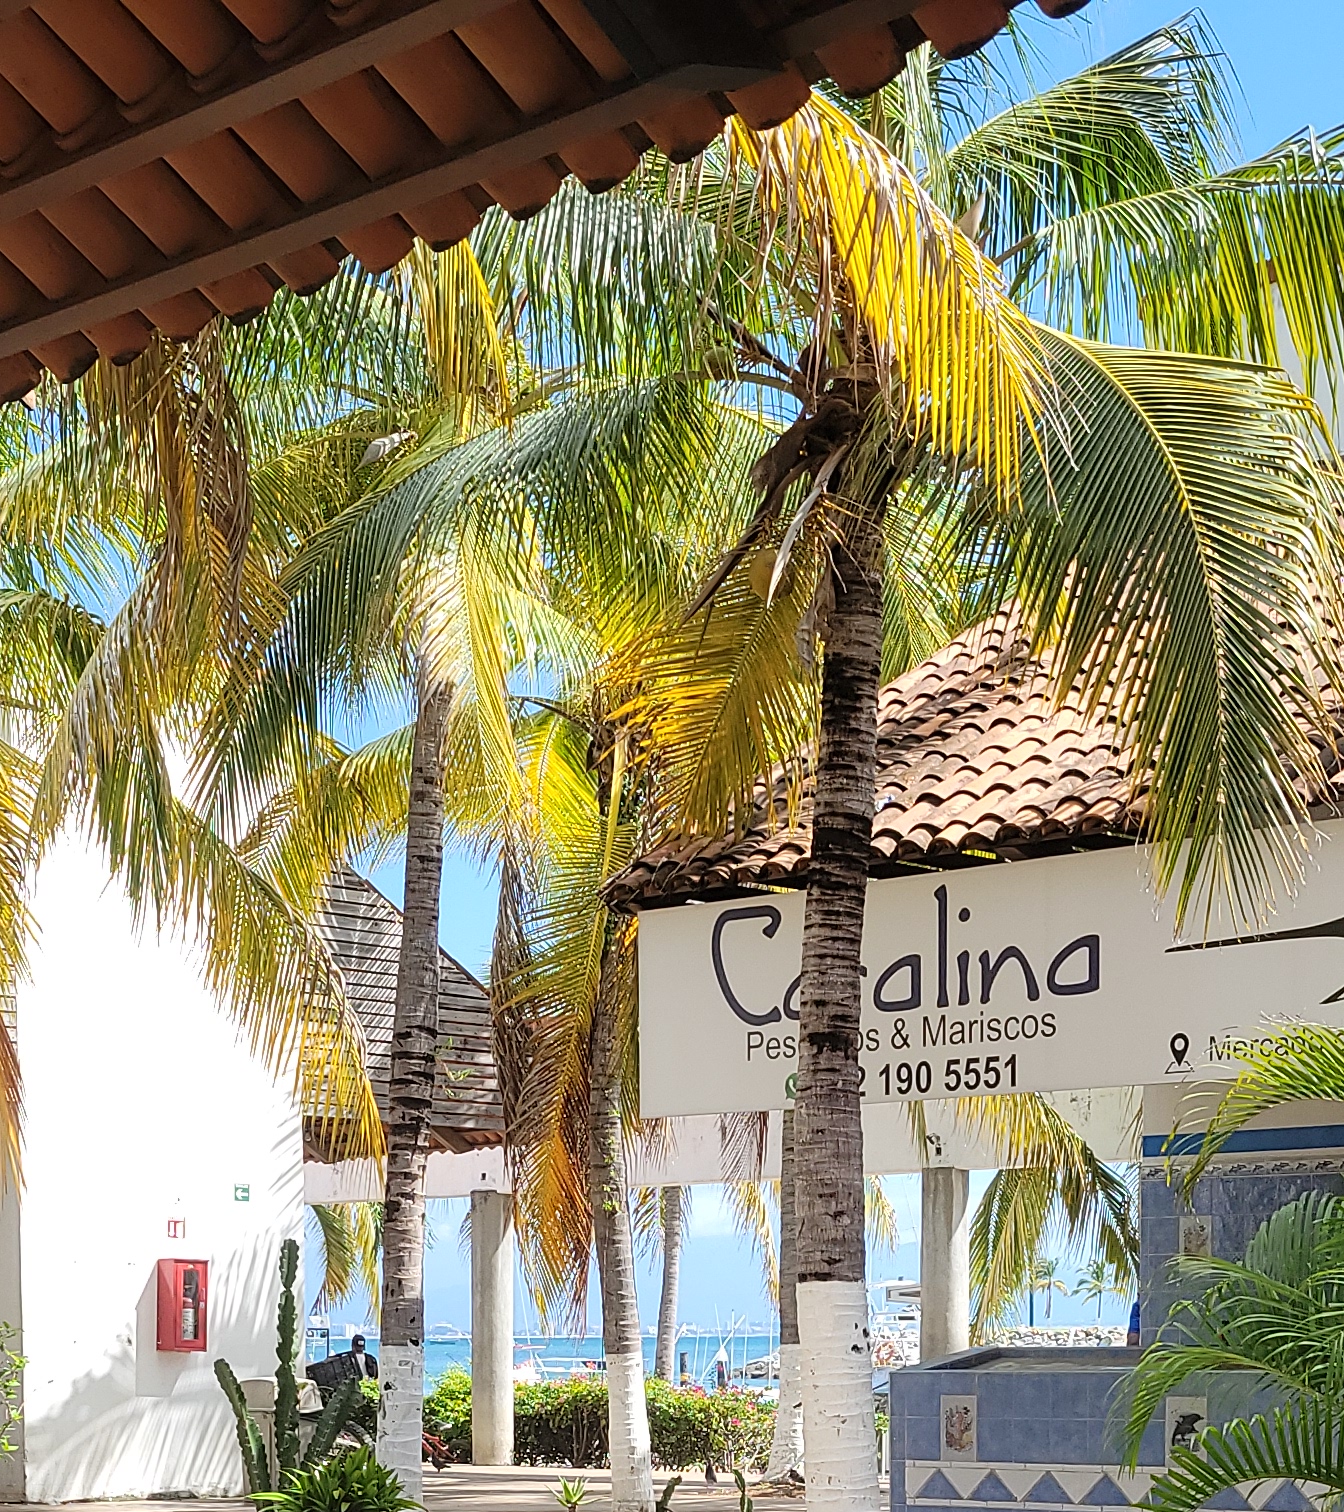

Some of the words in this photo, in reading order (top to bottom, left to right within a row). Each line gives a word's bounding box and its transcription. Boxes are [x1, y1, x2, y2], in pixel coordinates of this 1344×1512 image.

[712, 884, 1100, 1026] Calina
[746, 1028, 880, 1062] Pess
[891, 1017, 911, 1050] &
[922, 1010, 1057, 1048] Mariscos
[878, 1060, 932, 1096] 190
[944, 1053, 1018, 1092] 5551
